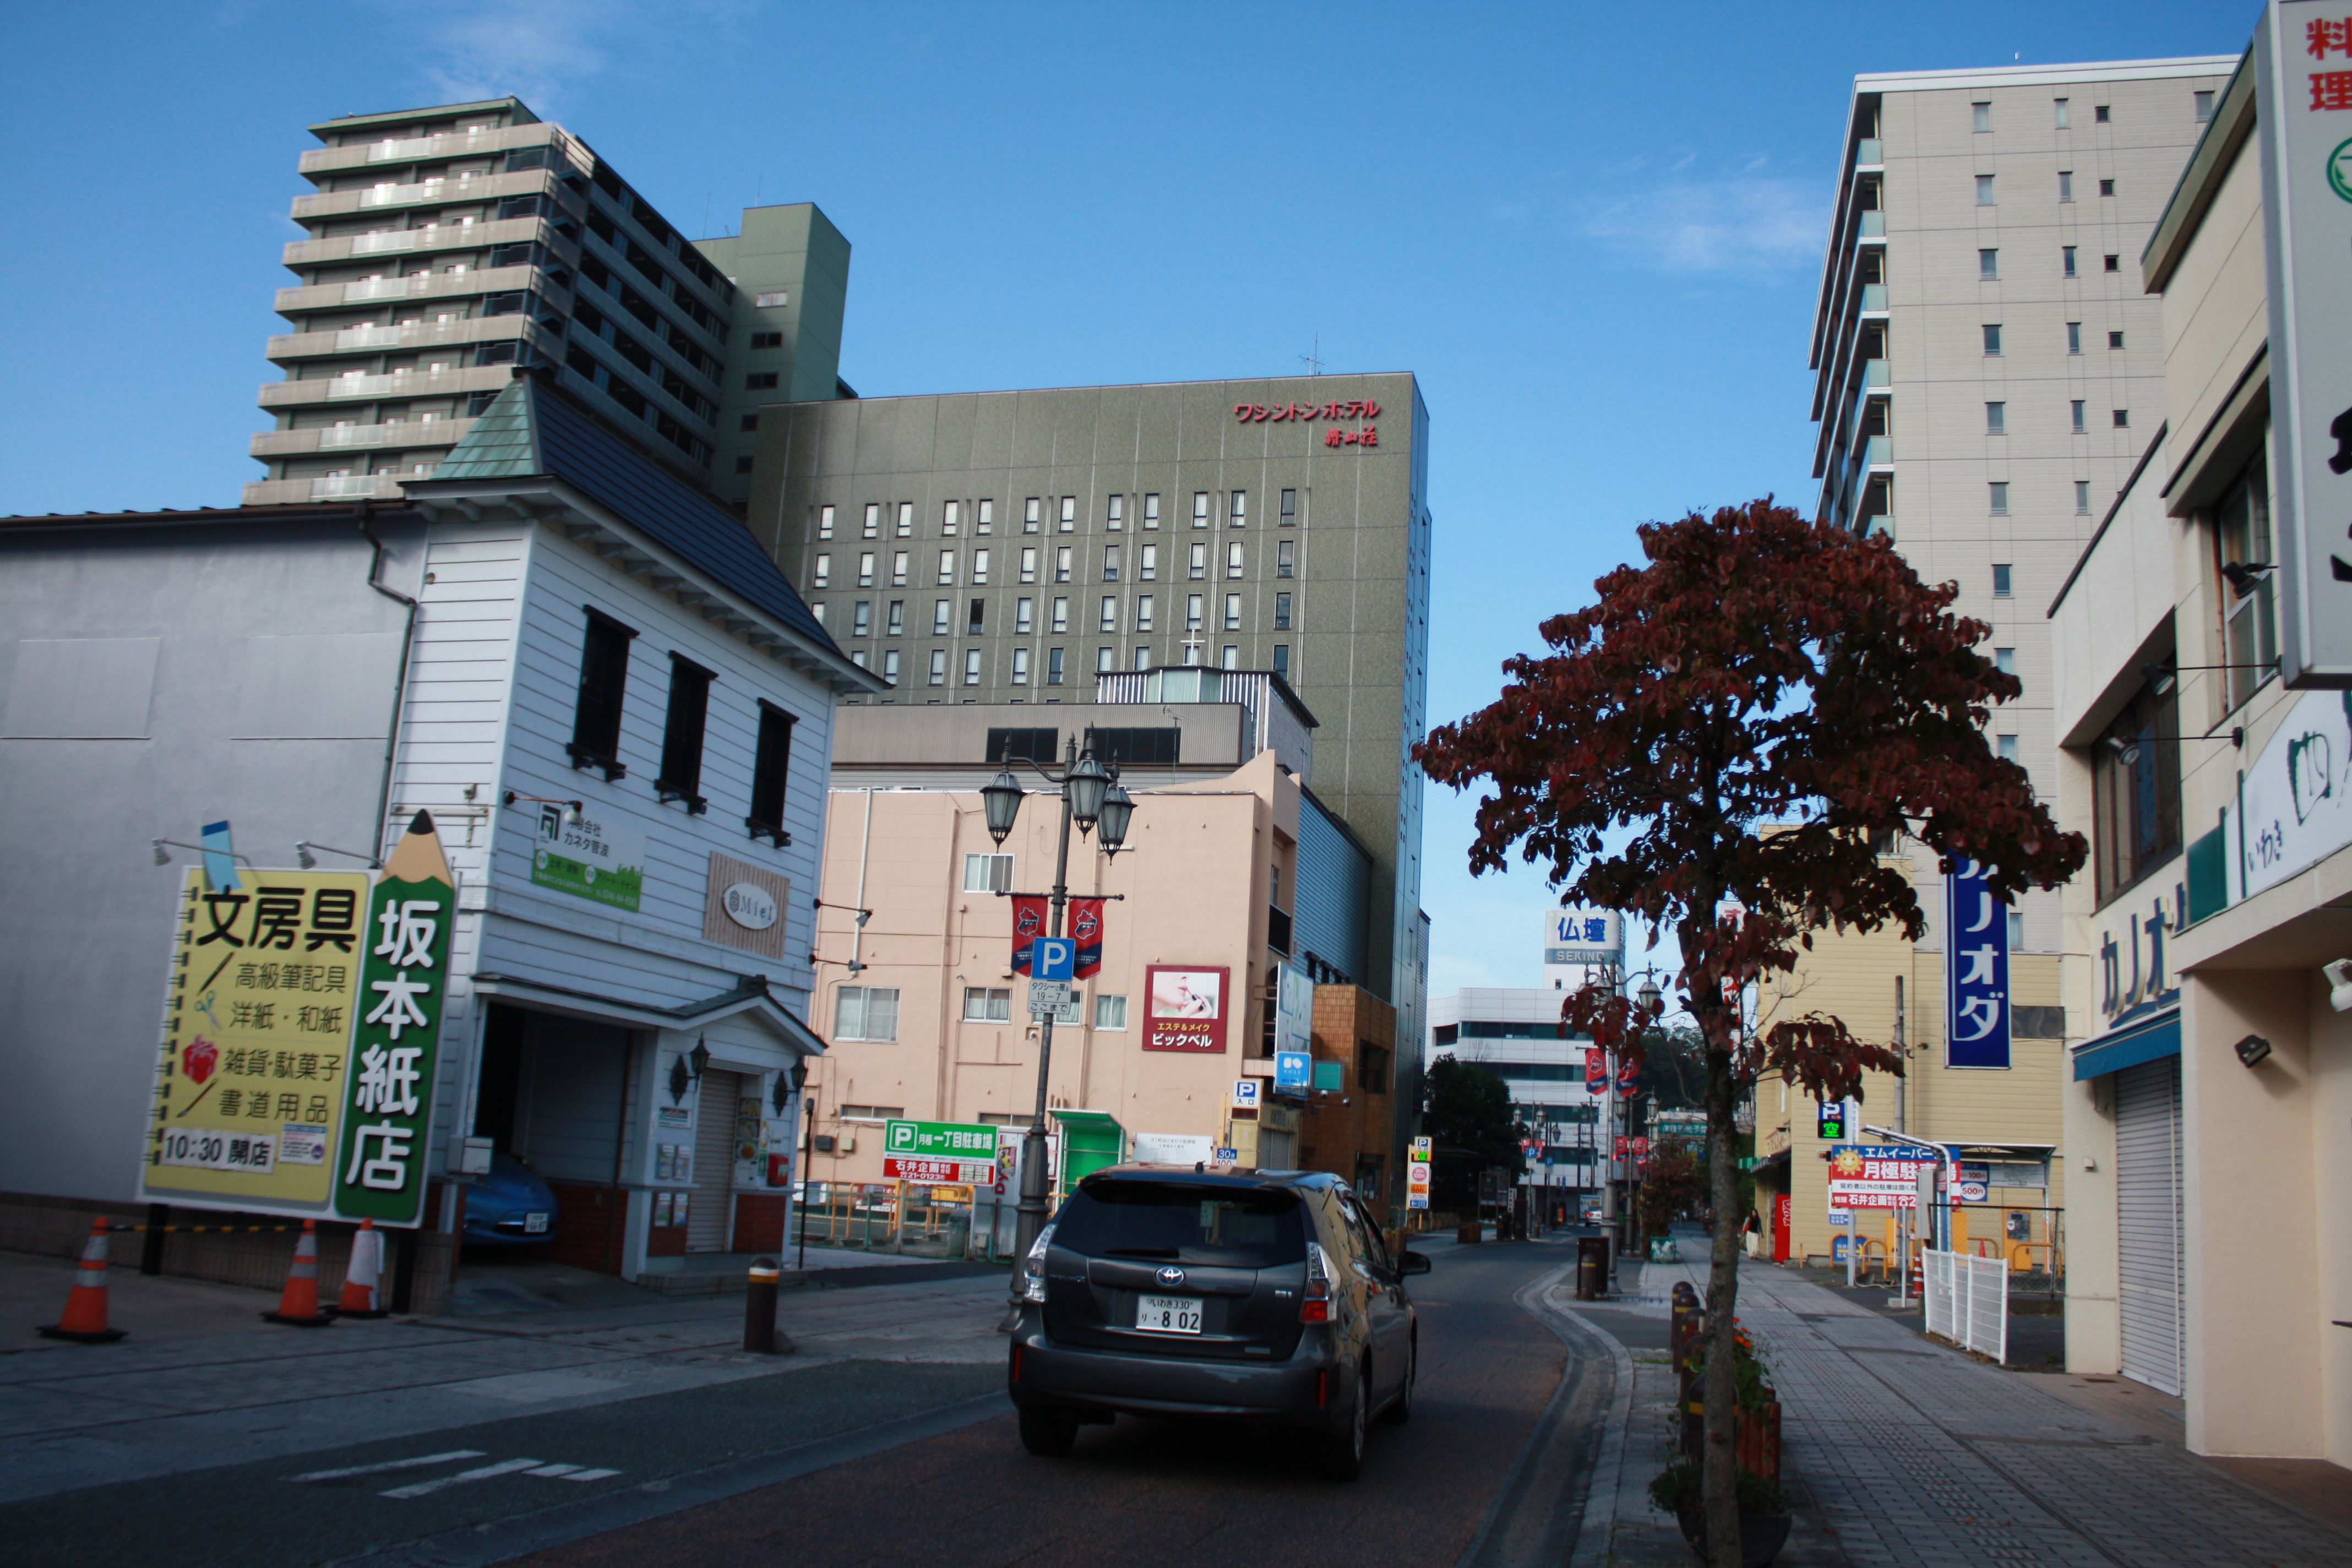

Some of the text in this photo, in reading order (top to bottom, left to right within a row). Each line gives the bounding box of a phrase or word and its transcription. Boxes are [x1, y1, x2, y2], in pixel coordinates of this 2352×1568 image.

[2306, 18, 2352, 112] 料理
[1233, 398, 1381, 422] ワシントンホテル
[564, 831, 609, 858] カネタ菅波
[2247, 819, 2282, 873] いわき
[196, 884, 358, 952] 文房具
[740, 896, 772, 921] Miel
[1558, 917, 1606, 942] 仏壇
[1042, 942, 1066, 976] P
[1557, 951, 1604, 962] SEKINO
[235, 960, 347, 994] 高級筆記具
[1031, 982, 1070, 992] タクシーに限る
[228, 1000, 342, 1035] 洋紙・和紙
[1030, 1004, 1068, 1012] ここまで
[346, 899, 440, 1191] 坂本紙店
[1152, 1033, 1213, 1048] ビックベル
[223, 1047, 342, 1082] 雑貨・駄菓子
[1237, 1098, 1255, 1106] 入口
[1238, 1083, 1254, 1096] P
[219, 1088, 329, 1123] 書道用品
[895, 1128, 912, 1147] P
[166, 1135, 222, 1162] 10:30
[227, 1138, 271, 1167] 開店
[1528, 1149, 1535, 1157] P
[1864, 1147, 1937, 1159] エムイーパー
